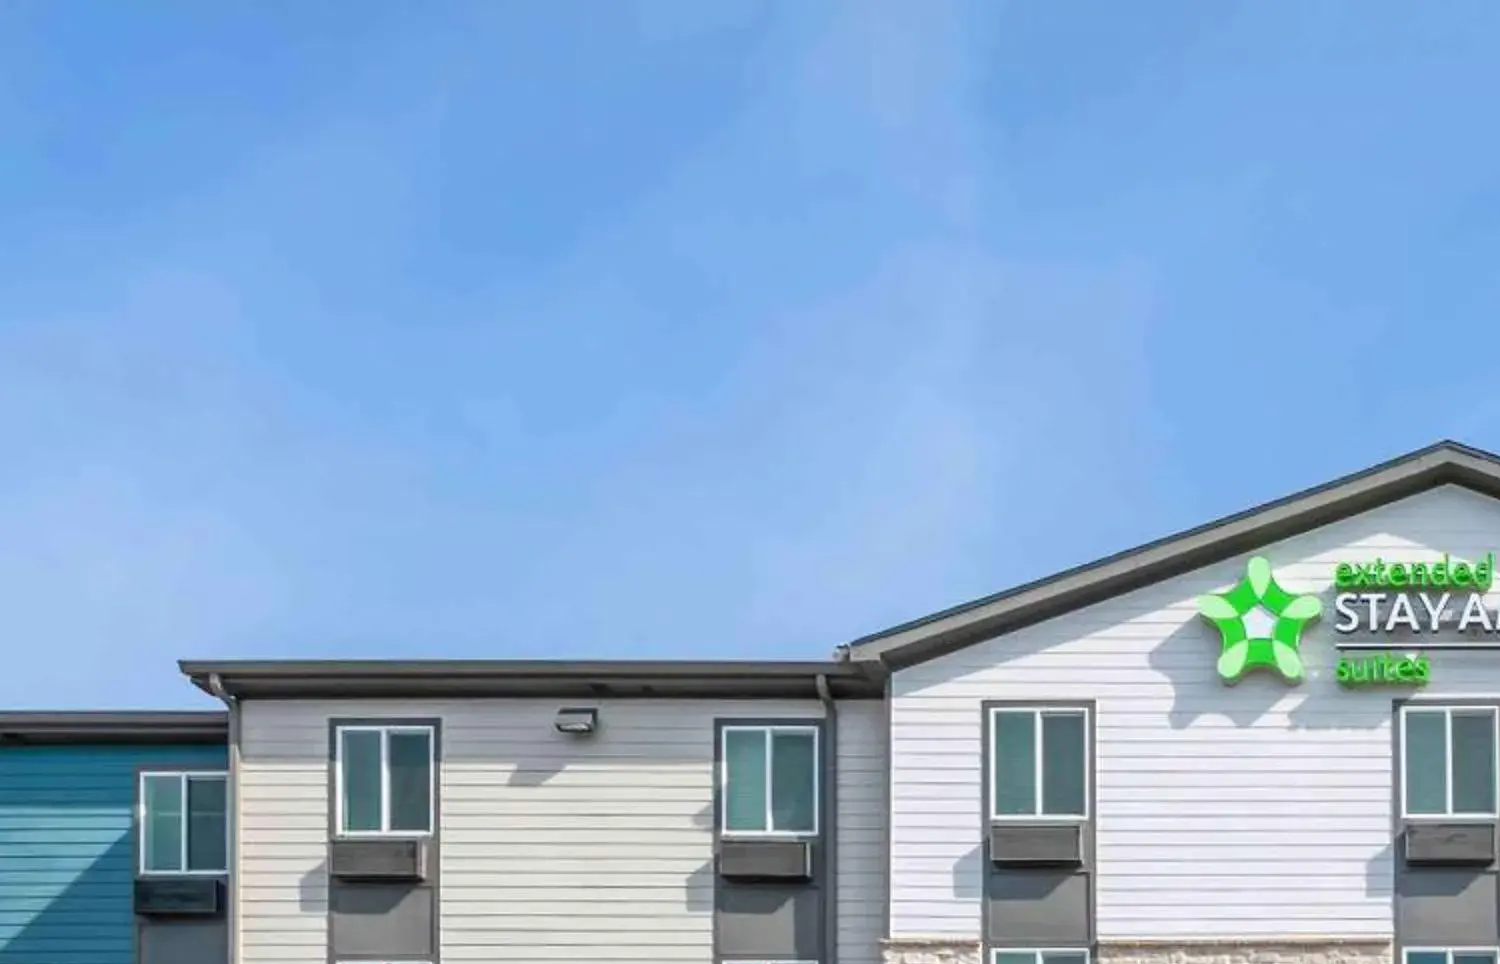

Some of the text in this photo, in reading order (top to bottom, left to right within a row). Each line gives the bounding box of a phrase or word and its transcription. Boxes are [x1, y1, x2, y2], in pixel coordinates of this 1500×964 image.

[1334, 551, 1494, 591] extended
[1335, 592, 1452, 633] STAY
[1336, 652, 1430, 685] suites
